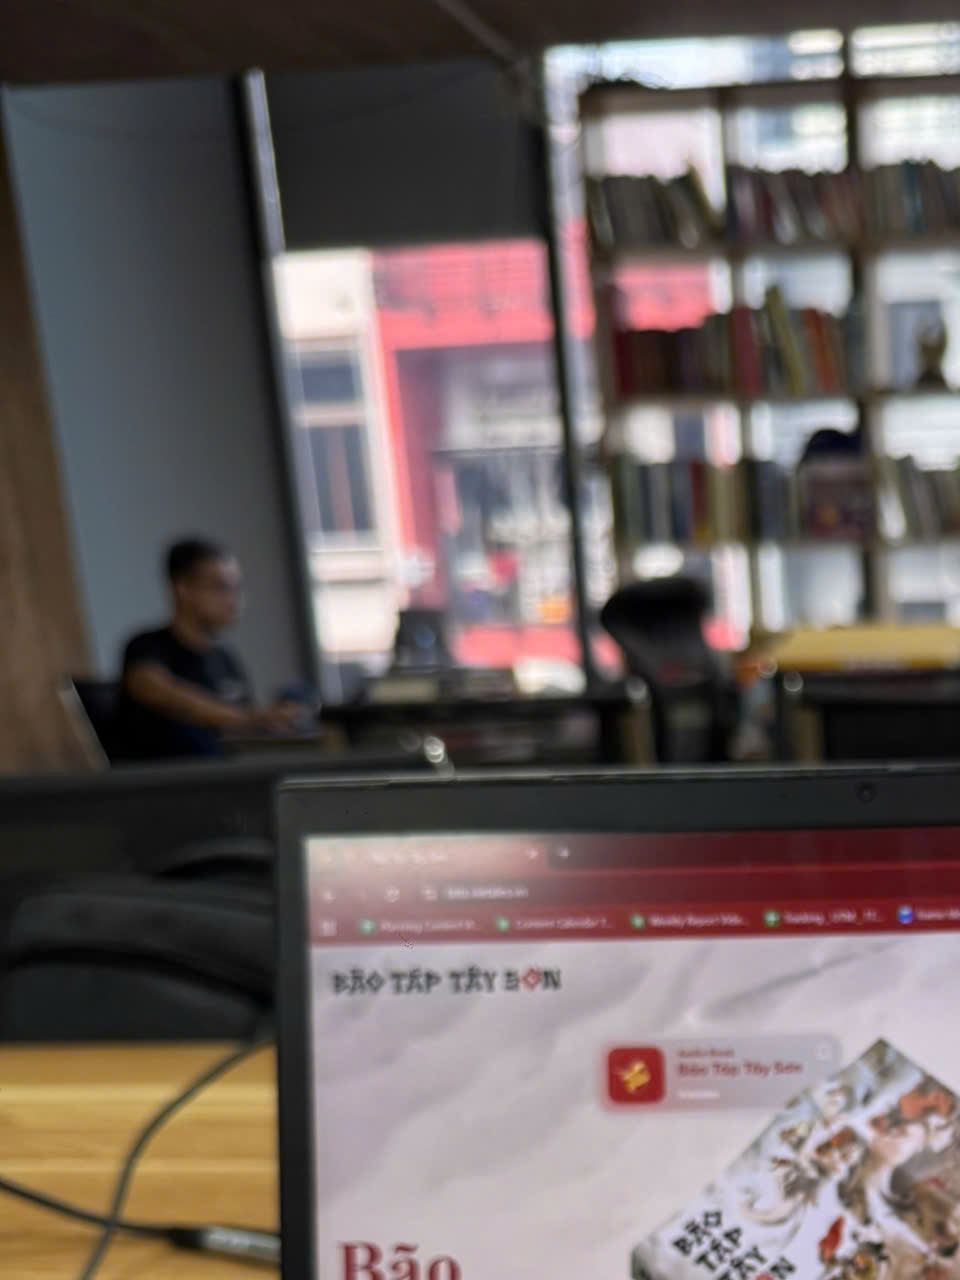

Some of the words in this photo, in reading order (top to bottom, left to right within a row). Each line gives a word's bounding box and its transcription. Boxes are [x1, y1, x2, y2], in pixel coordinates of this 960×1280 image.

[332, 964, 385, 995] BÃO
[391, 964, 441, 994] TÁP
[449, 963, 498, 993] TÂY
[504, 967, 561, 991] SƠN
